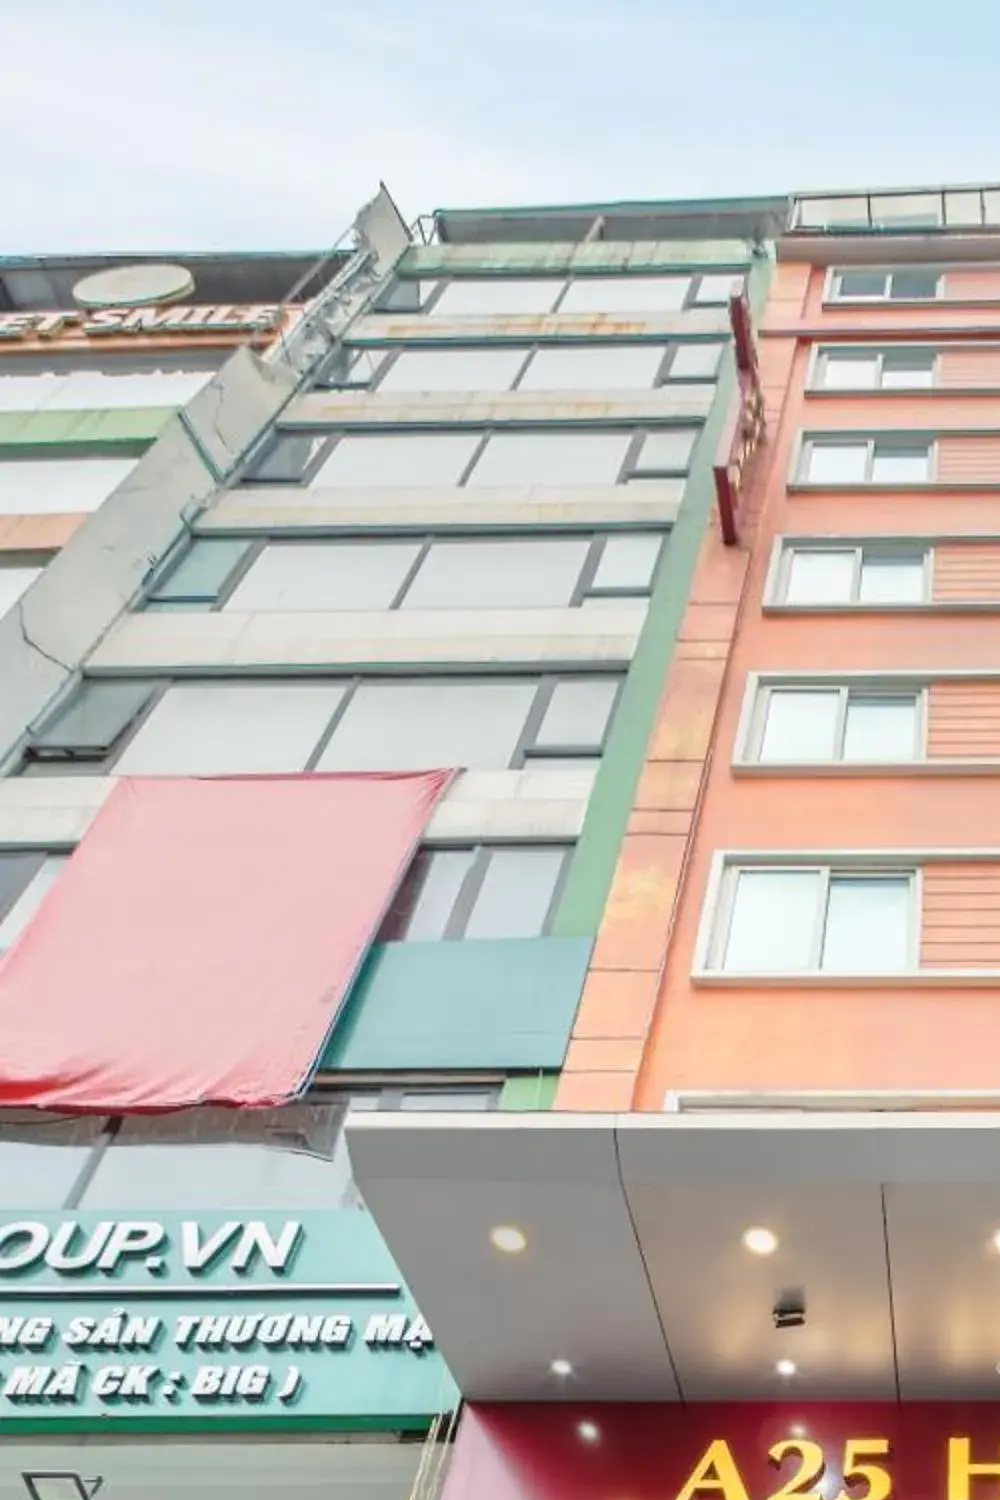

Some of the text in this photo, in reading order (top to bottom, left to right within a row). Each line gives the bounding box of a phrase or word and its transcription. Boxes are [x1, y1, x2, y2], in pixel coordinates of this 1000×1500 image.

[175, 1313, 352, 1347] THƯƠNG
[4, 1361, 84, 1401] MÃ
[190, 1365, 272, 1401] BIG
